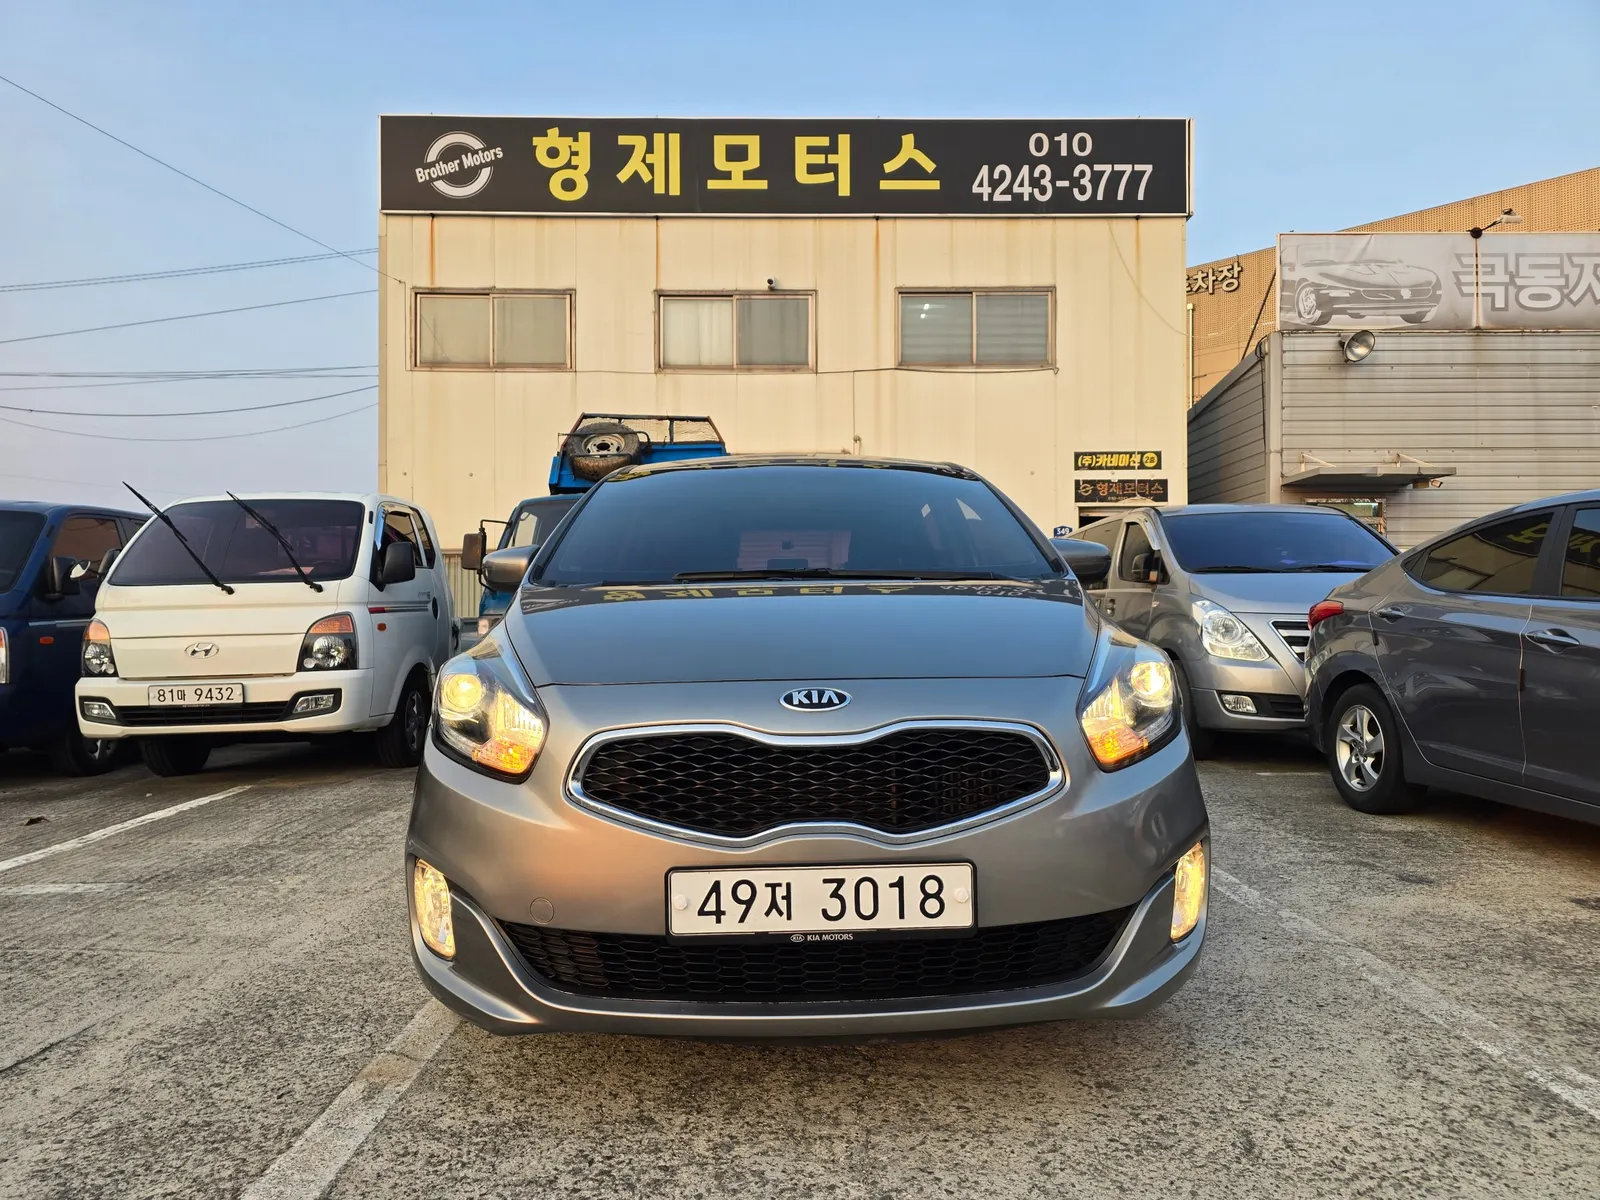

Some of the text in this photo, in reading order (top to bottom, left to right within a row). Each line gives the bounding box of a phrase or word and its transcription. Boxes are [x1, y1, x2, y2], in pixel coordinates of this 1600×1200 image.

[1028, 132, 1093, 157] 010
[415, 147, 503, 183] Brother Motors
[532, 126, 941, 202] 형제모터스
[971, 163, 1154, 202] 4243-3777
[1056, 527, 1069, 535] 349
[157, 686, 234, 702] 81마 9432
[792, 690, 840, 705] KIA
[697, 874, 946, 925] 49저 3018
[807, 933, 854, 942] KIA MOTORS
